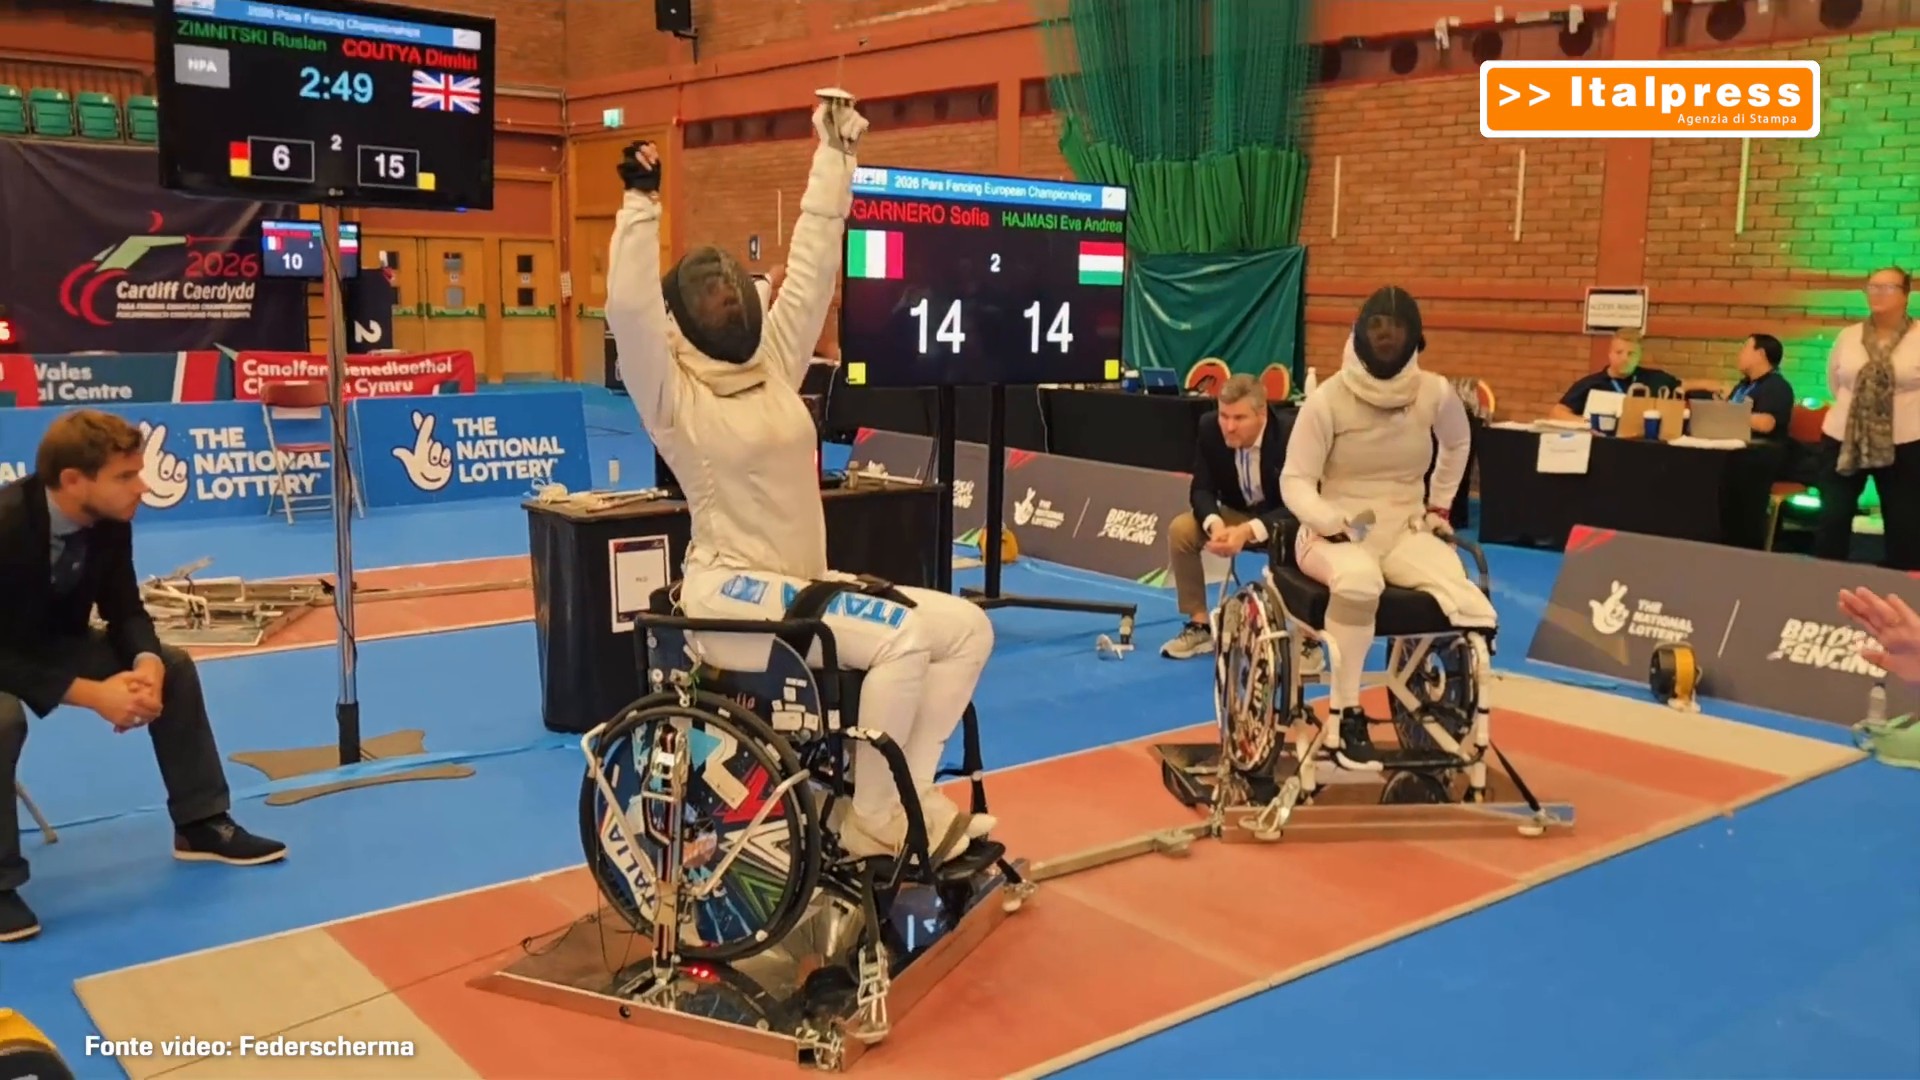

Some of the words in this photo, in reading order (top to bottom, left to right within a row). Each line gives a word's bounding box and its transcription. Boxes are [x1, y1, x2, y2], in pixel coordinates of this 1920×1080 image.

[272, 31, 327, 52] Ruslan
[299, 67, 374, 104] 2:49
[331, 134, 342, 151] 2
[272, 144, 291, 171] 6
[375, 154, 405, 179] 15
[853, 199, 946, 224] GARNERO
[950, 205, 990, 227] Sofia
[1001, 211, 1058, 230] HAJMASI
[1060, 214, 1082, 231] Eva
[1084, 216, 1124, 233] Andrea
[185, 251, 259, 278] 2026
[282, 252, 303, 270] 10
[990, 253, 1001, 272] 2
[116, 280, 180, 300] Cardiff
[183, 281, 256, 303] Caerdydd
[910, 298, 966, 354] 14
[1023, 300, 1073, 354] 14
[345, 357, 453, 377] enedlaethol
[58, 382, 133, 400] Centre
[355, 378, 414, 398] Cymru
[189, 427, 246, 449] THE
[453, 416, 498, 438] THE
[456, 435, 565, 460] NATIONAL
[194, 449, 330, 475] NATIONAL
[459, 458, 556, 483] LOTTERY
[196, 473, 317, 500] LOTTERY
[1638, 599, 1663, 614] THE
[1628, 621, 1688, 643] LOTTERY
[1632, 611, 1694, 634] NATIONAL
